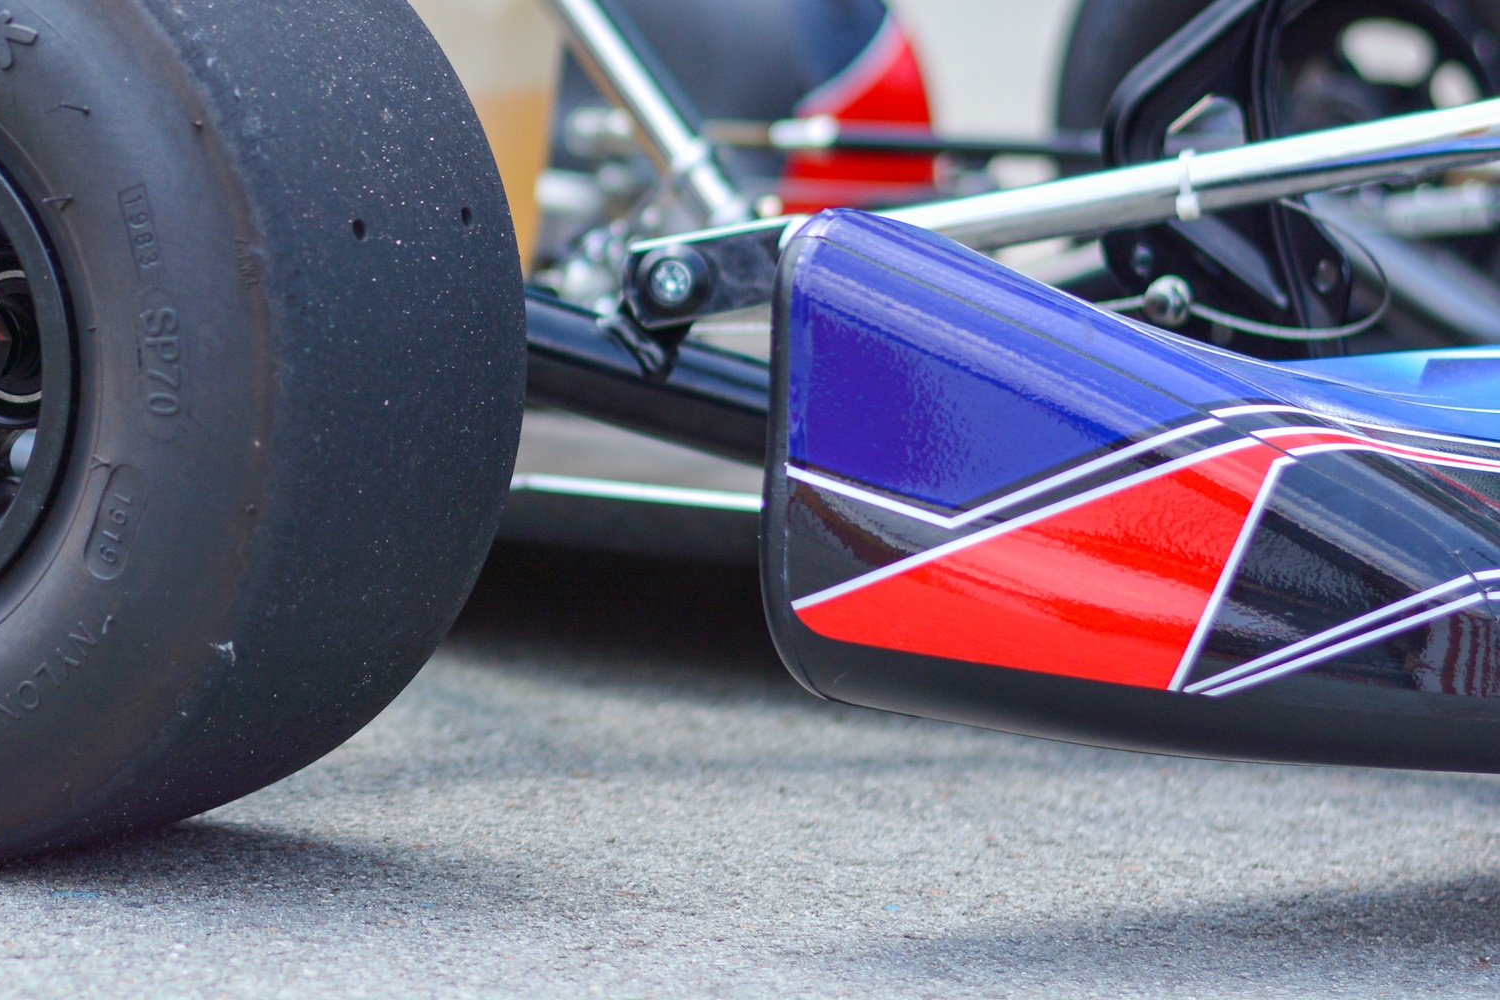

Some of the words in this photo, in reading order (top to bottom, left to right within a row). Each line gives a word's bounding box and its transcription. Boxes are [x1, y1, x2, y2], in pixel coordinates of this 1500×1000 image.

[124, 193, 160, 270] 1983
[139, 305, 181, 417] SP70
[99, 492, 133, 565] 1919
